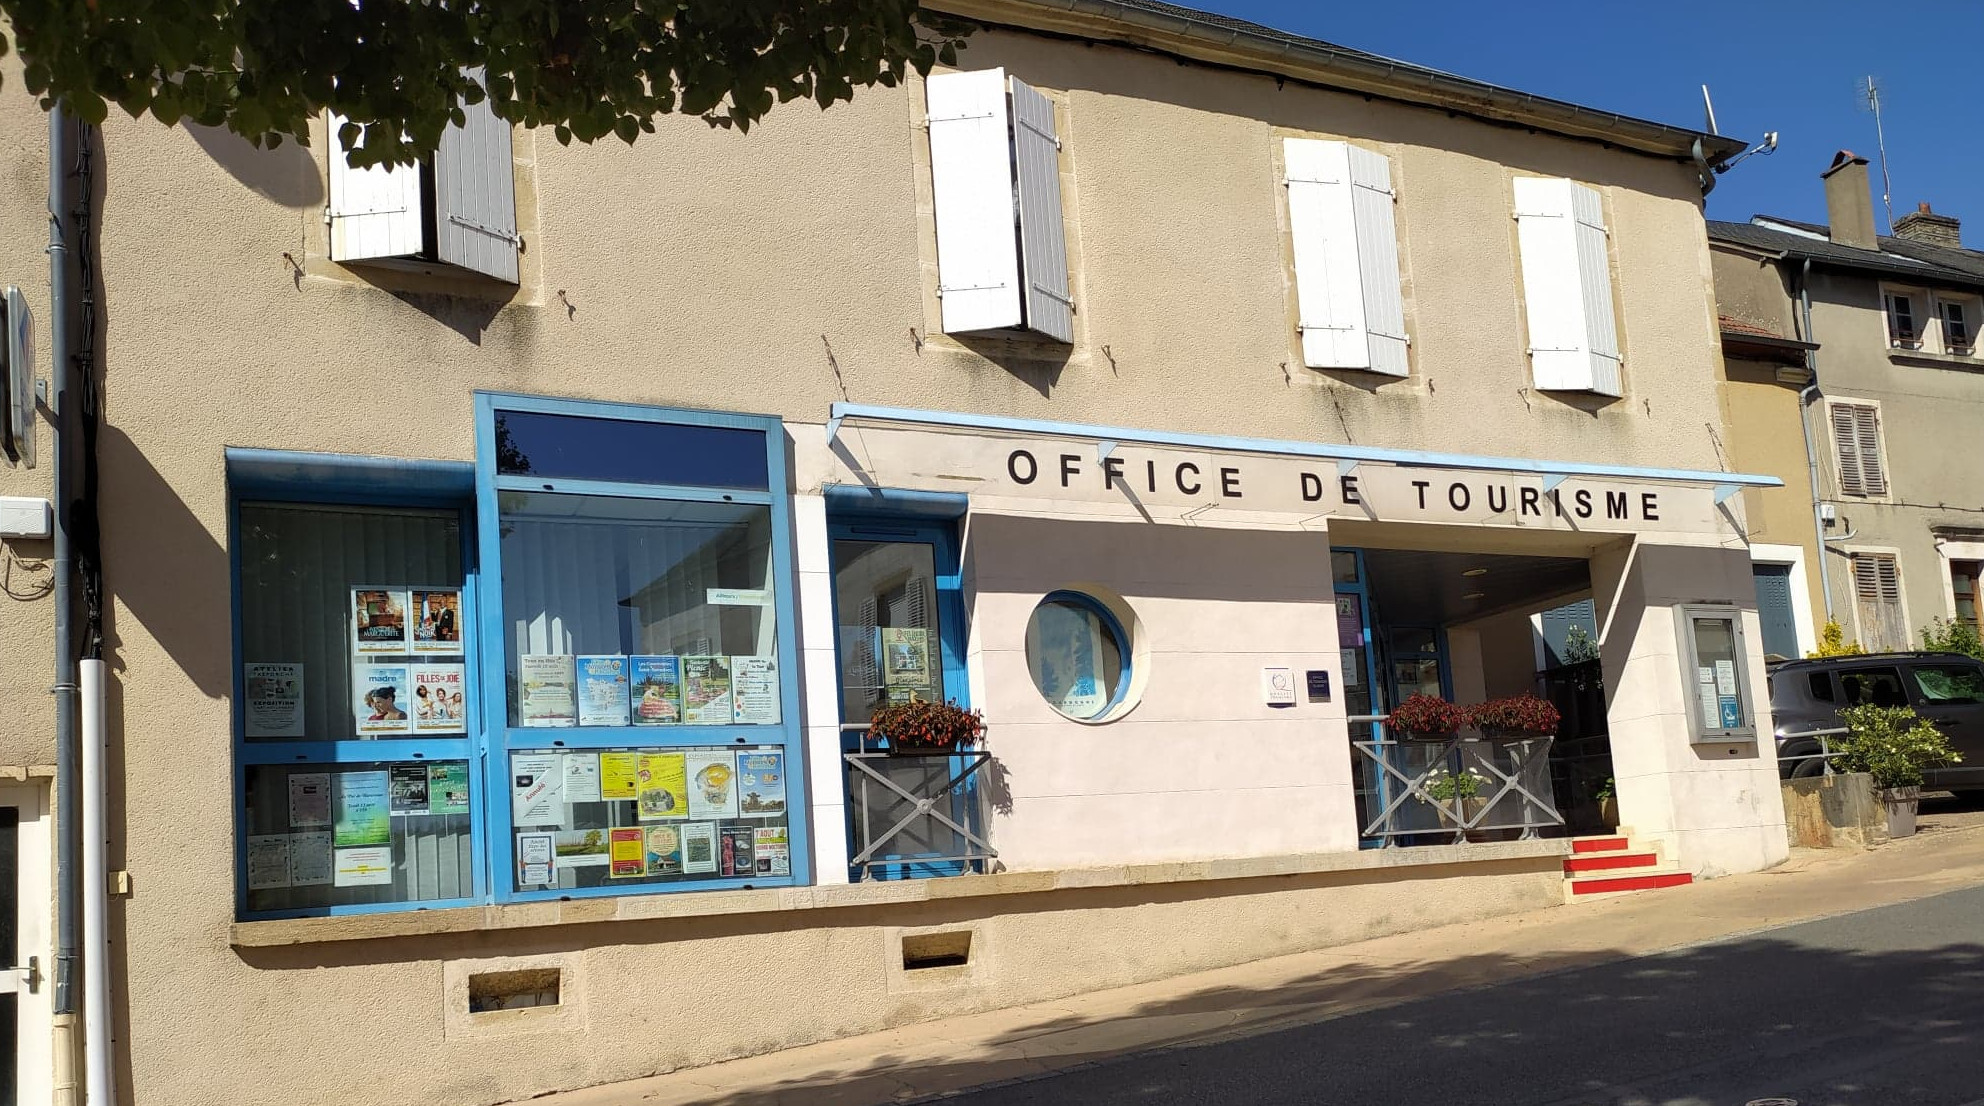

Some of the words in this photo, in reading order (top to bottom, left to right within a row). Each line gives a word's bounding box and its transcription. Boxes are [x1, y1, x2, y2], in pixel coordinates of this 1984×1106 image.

[1008, 450, 1242, 498] OFFICE
[1301, 473, 1361, 505] DE
[1412, 482, 1659, 521] TOURISME
[416, 674, 440, 683] FILLES
[446, 674, 460, 683] JOIE
[525, 782, 546, 802] Annulé
